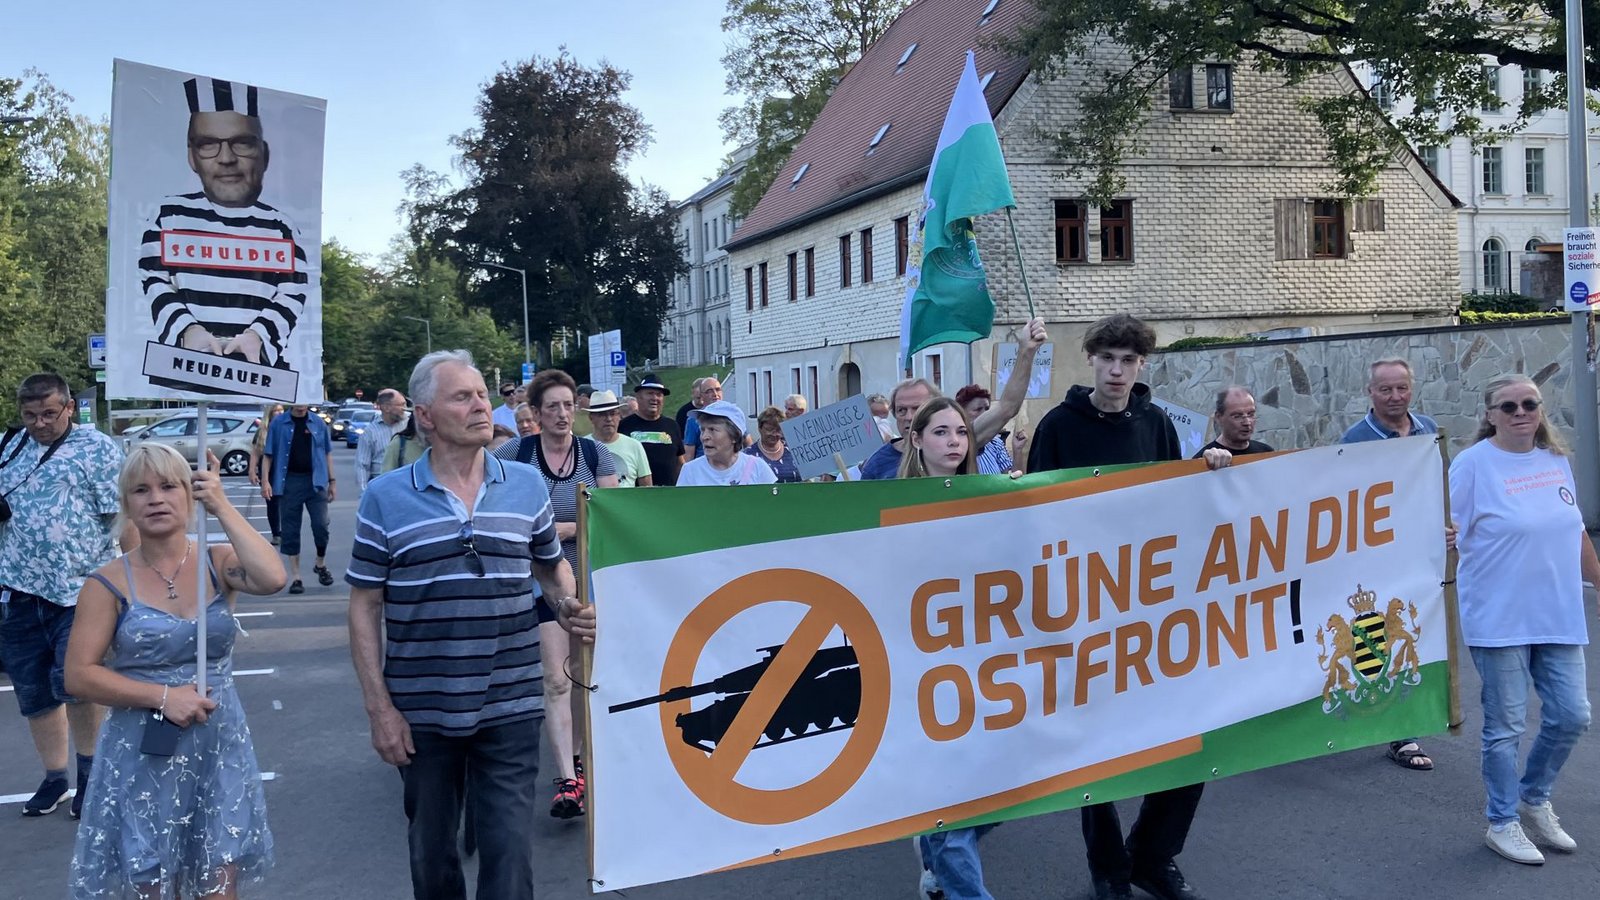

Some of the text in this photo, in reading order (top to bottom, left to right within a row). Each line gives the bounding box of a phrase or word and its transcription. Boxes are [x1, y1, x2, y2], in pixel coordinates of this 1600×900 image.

[1567, 232, 1595, 241] Freiheit
[1568, 242, 1597, 251] braucht
[171, 243, 286, 263] SCHULDIG
[1568, 252, 1595, 261] soziale
[613, 353, 622, 365] P
[172, 357, 272, 388] NEUBAUER
[793, 407, 853, 441] MEINUNGS
[791, 425, 863, 466] PRESSEFREIHEIT
[910, 480, 1396, 653] GRÜNE AN DIE
[917, 578, 1304, 742] OSTFRONT!
